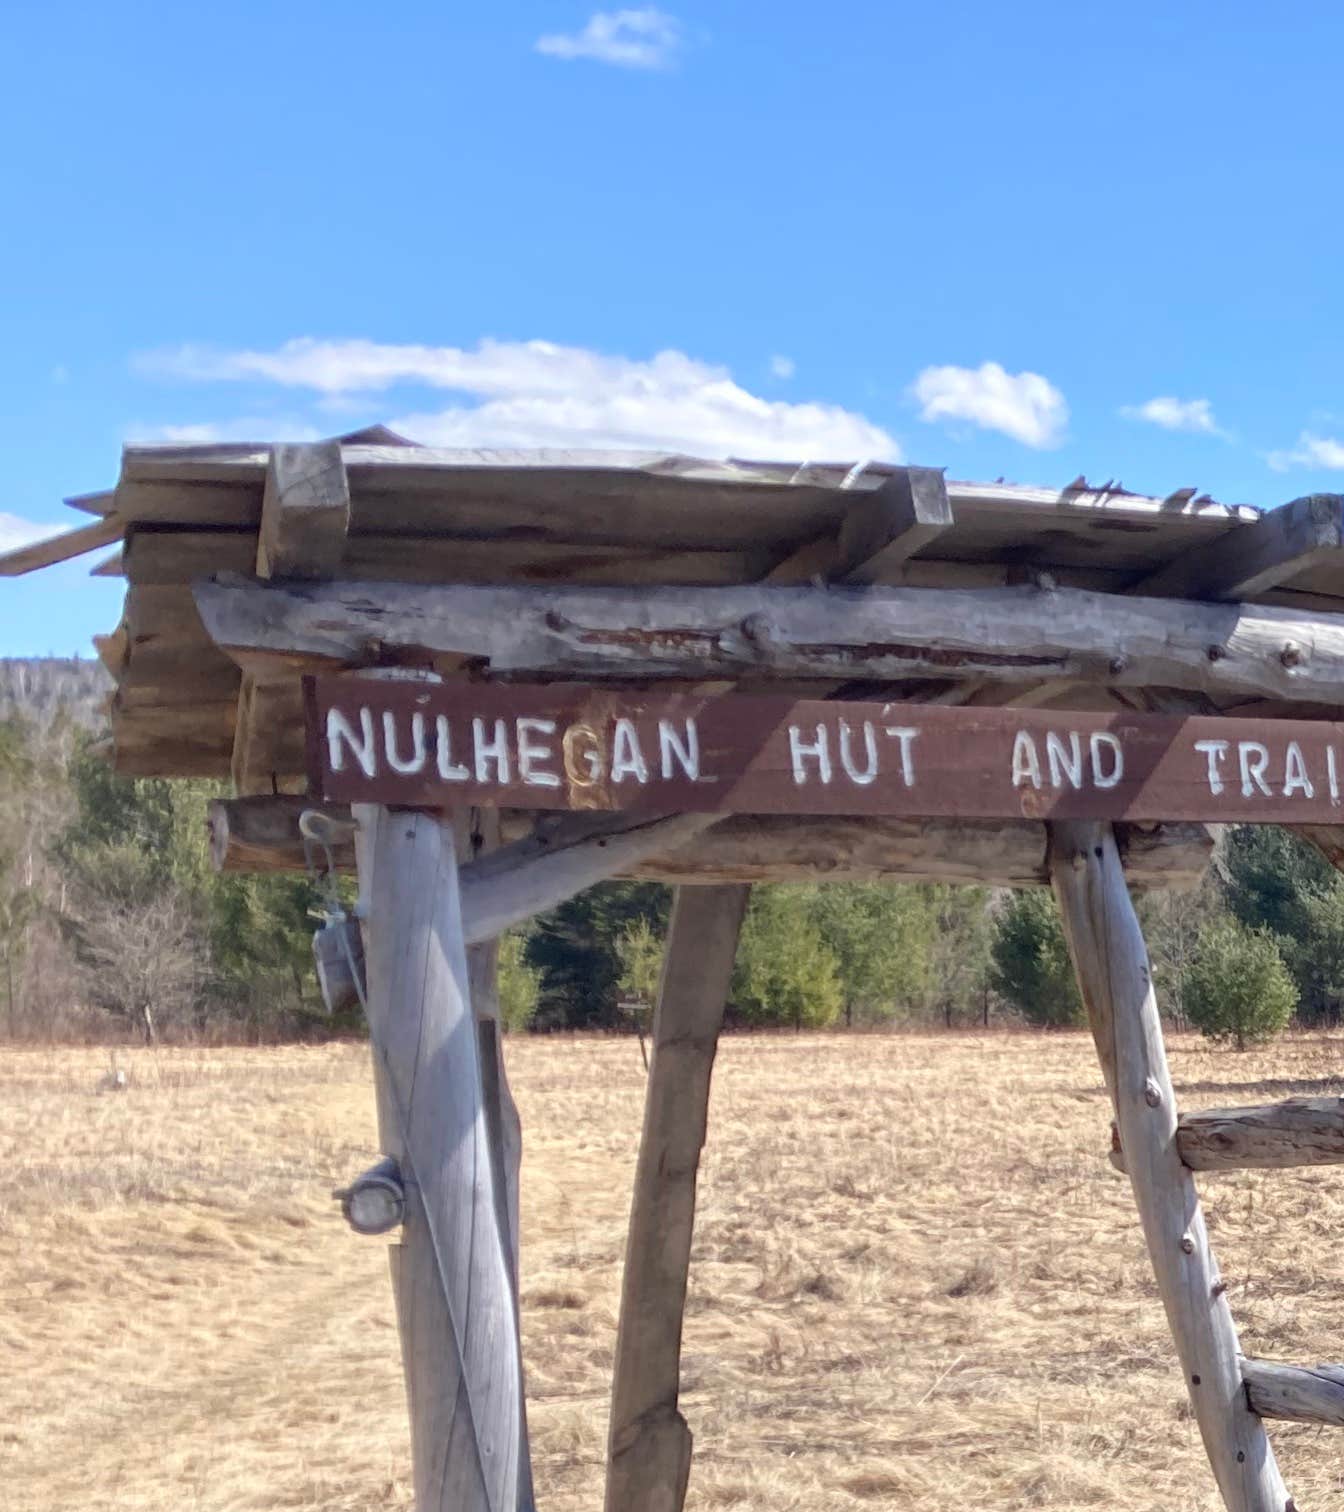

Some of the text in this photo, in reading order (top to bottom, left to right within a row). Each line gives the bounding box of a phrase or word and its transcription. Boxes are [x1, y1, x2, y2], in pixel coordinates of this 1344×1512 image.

[325, 705, 702, 788] NULHEGAN
[788, 719, 922, 787] HUT
[1010, 729, 1126, 791] AND
